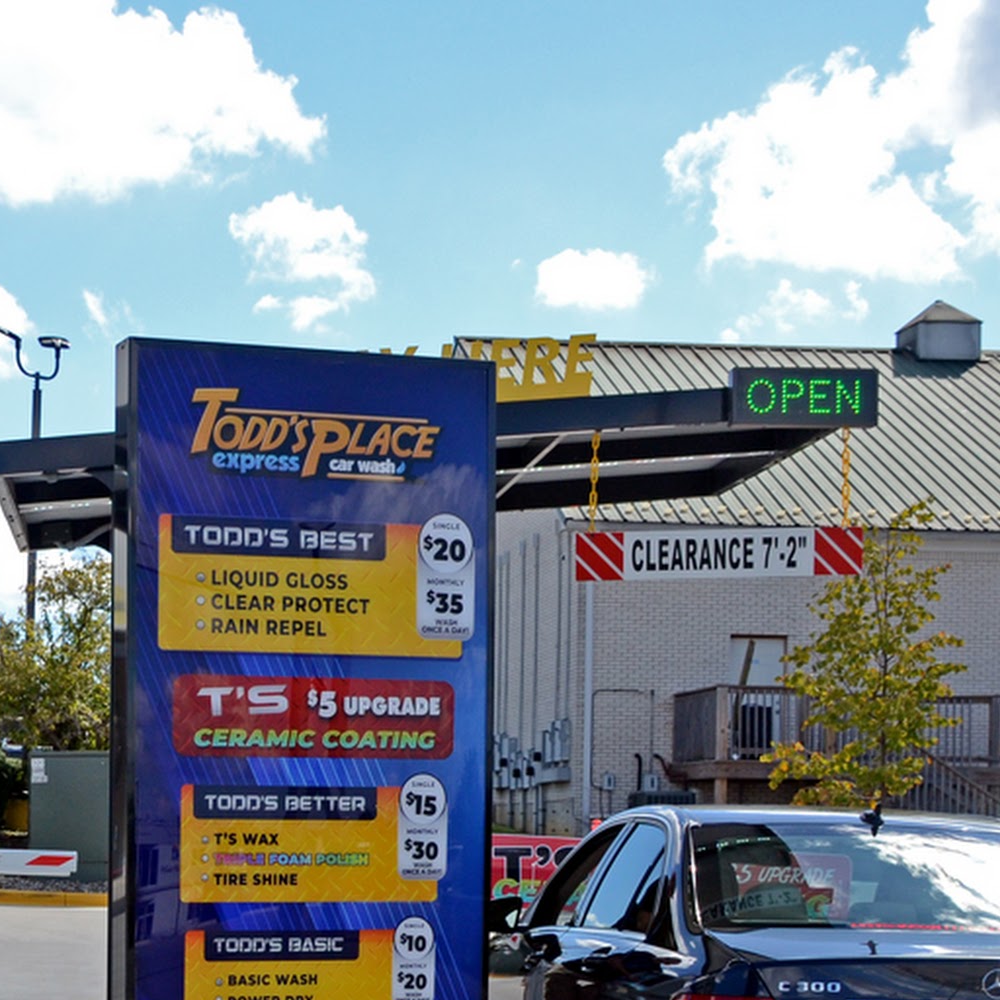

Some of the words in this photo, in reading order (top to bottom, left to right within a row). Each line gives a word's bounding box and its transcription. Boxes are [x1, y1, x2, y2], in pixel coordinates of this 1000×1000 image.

[440, 333, 597, 388] ERE
[746, 378, 862, 415] OPEN
[191, 387, 307, 454] TODD'S
[301, 418, 441, 478] PLACE
[212, 452, 300, 473] express
[329, 459, 355, 472] car
[357, 458, 396, 474] wash
[432, 522, 460, 531] SINGLE
[184, 525, 289, 548] TODD'S
[300, 529, 374, 552] BEST
[423, 534, 466, 562] $20
[631, 537, 755, 572] CLEARANCE
[762, 536, 808, 570] 7'-2"
[211, 570, 279, 589] LIQUID
[286, 572, 349, 590] GLOSS
[426, 578, 465, 587] MONTHLY
[211, 594, 275, 612] CLEAR
[282, 596, 370, 615] PROTECT
[426, 589, 464, 615] $35
[211, 618, 259, 635] RAIN
[266, 620, 327, 637] REPEL
[197, 684, 289, 717] T'S
[307, 689, 338, 718] $5
[343, 695, 441, 717] UPGRADE
[193, 728, 316, 749] CERAMIC
[322, 729, 436, 750] COATING
[205, 794, 278, 811] TODD'S
[285, 795, 366, 812] BETTER
[405, 791, 437, 816] $15
[214, 833, 237, 846] T'S
[242, 833, 279, 846] WAX
[404, 838, 439, 860] $30
[214, 854, 265, 866] TRIPLE
[269, 854, 312, 866] FOAM
[315, 853, 369, 866] POLISH
[214, 873, 247, 886] TIRE
[252, 873, 298, 886] SHINE
[758, 865, 836, 885] UPGRADE
[214, 937, 283, 953] TODD'S
[288, 936, 344, 952] BASIC
[400, 932, 427, 952] $10
[228, 974, 270, 986] BASIC
[276, 974, 318, 986] WASH
[397, 971, 427, 990] $20
[778, 981, 791, 993] C
[796, 981, 841, 993] 300
